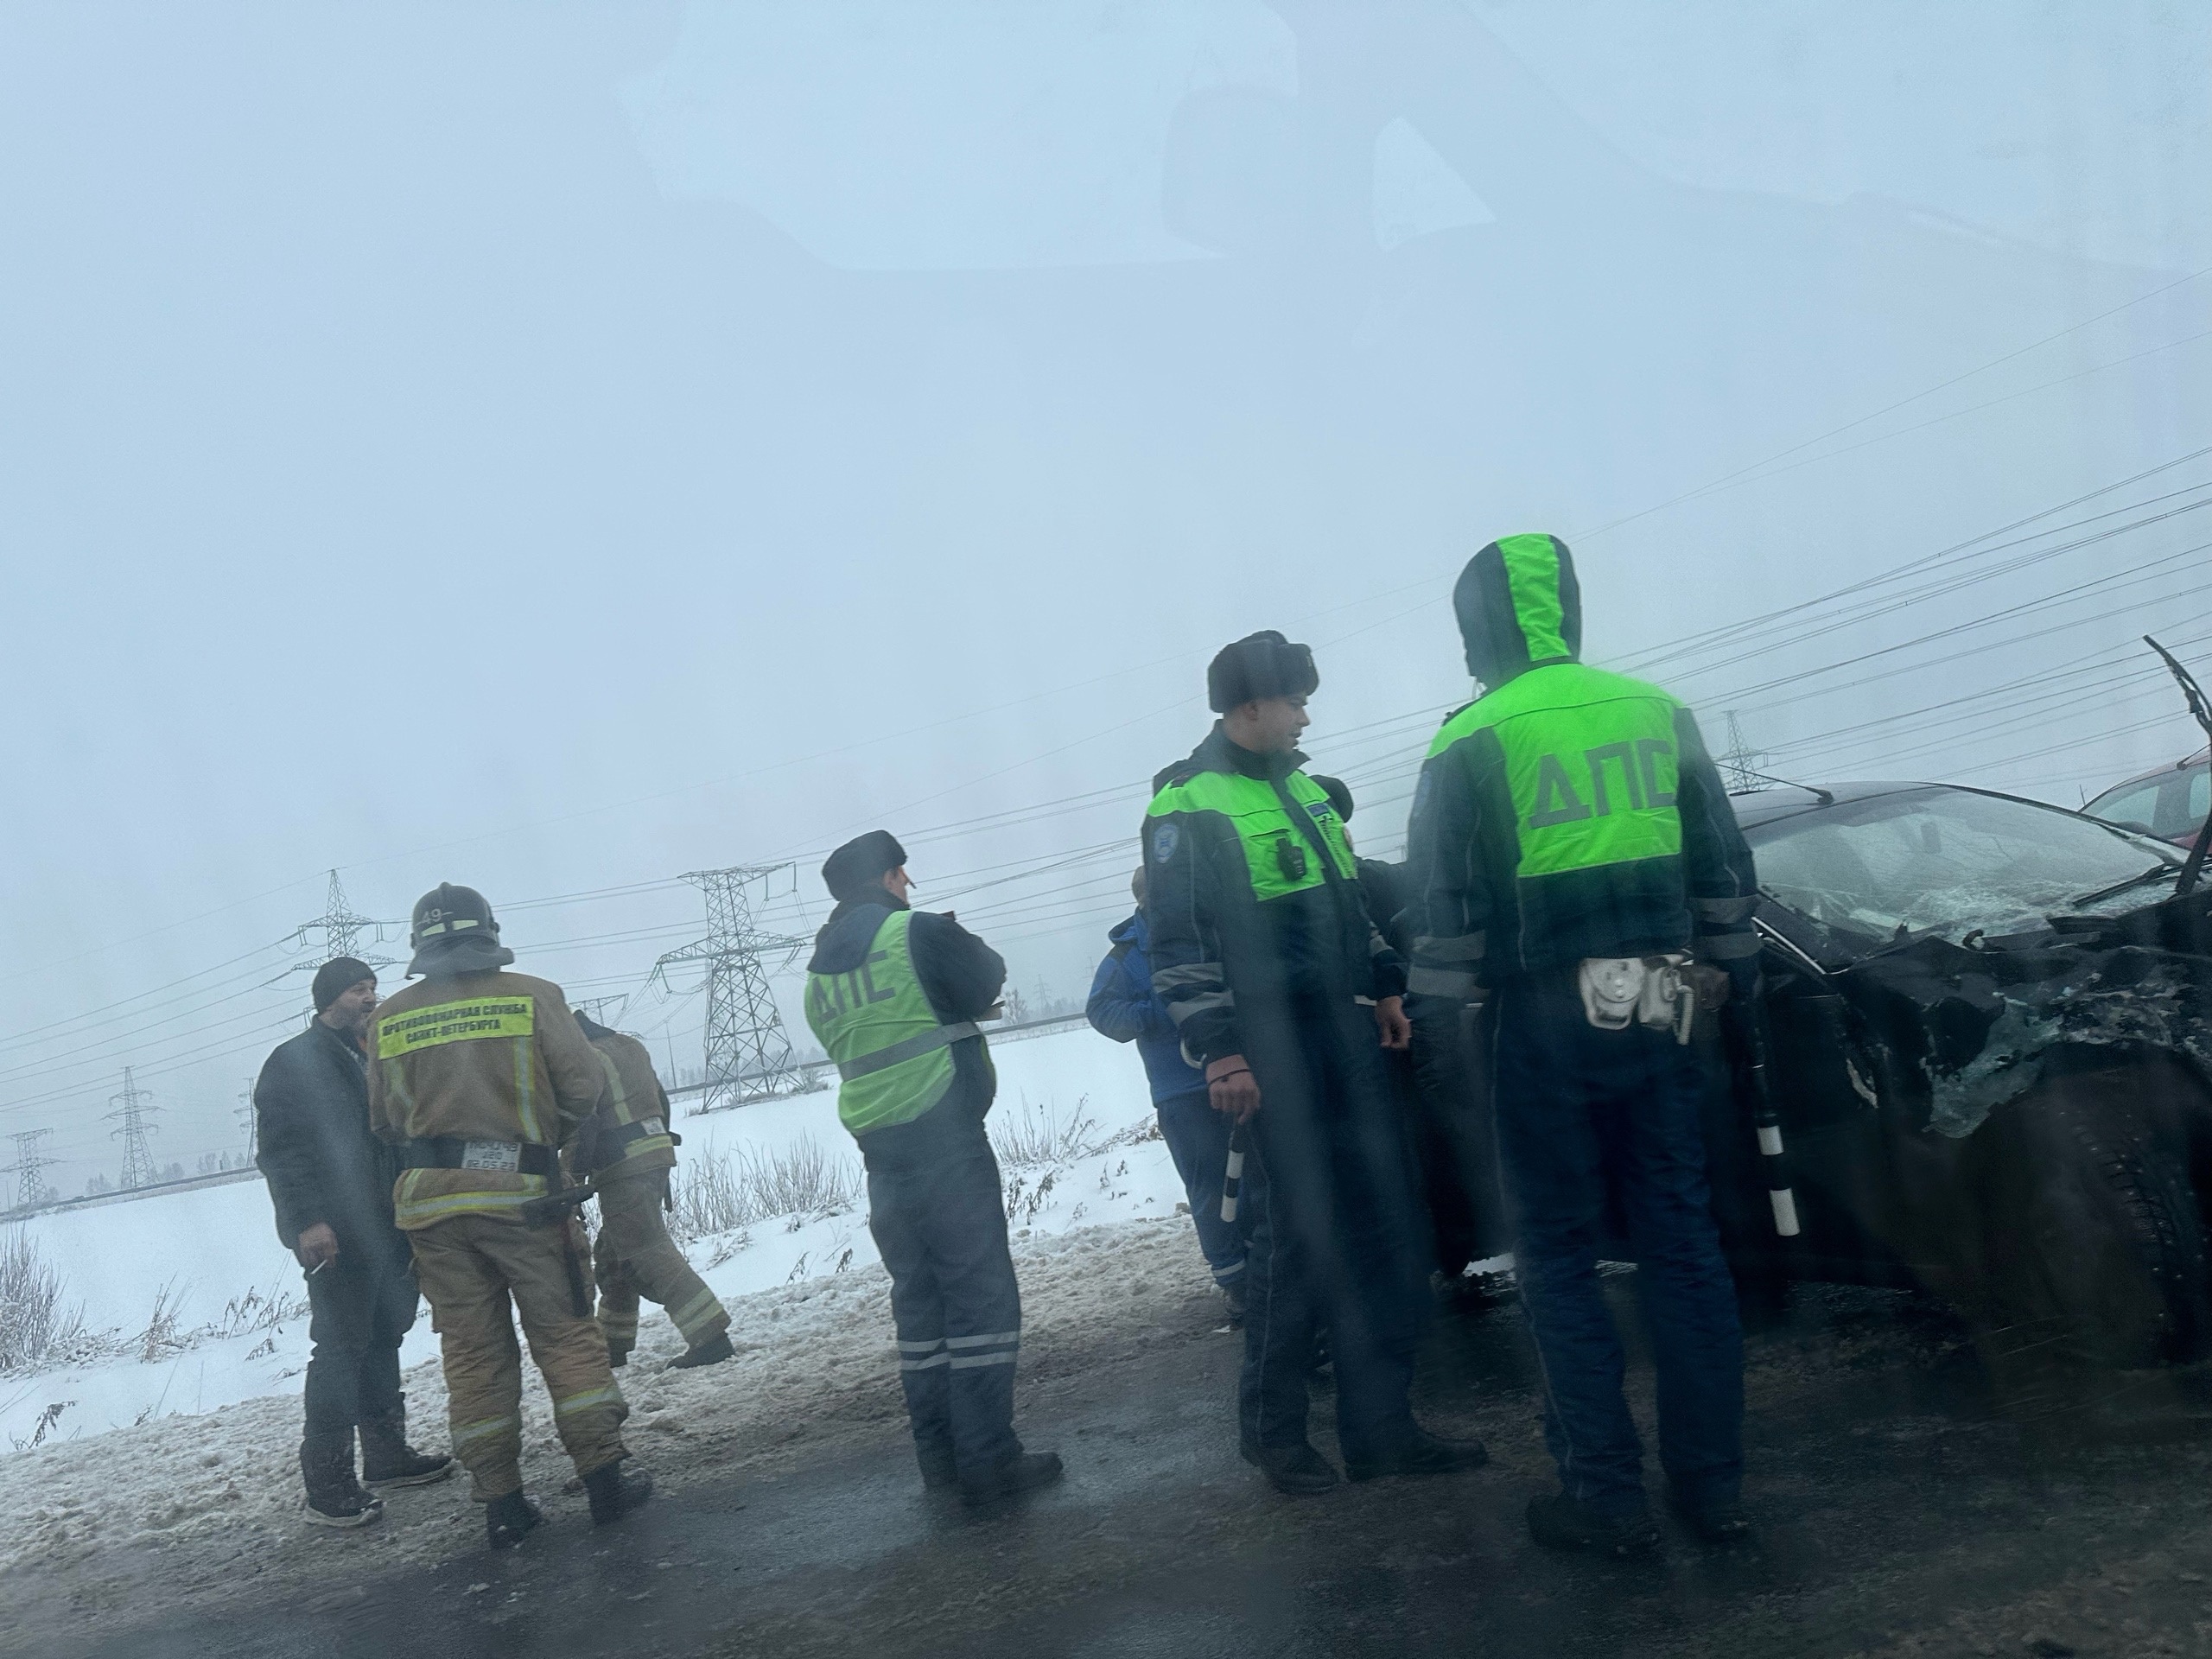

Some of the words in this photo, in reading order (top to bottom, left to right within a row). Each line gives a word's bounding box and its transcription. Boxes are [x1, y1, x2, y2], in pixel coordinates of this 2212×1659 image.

[1529, 739, 1677, 830] ДПС
[422, 908, 442, 924] 49
[483, 1003, 526, 1015] СЛУЖБА
[405, 1019, 500, 1044] САНКТ-ПЕТЕРБУРГА
